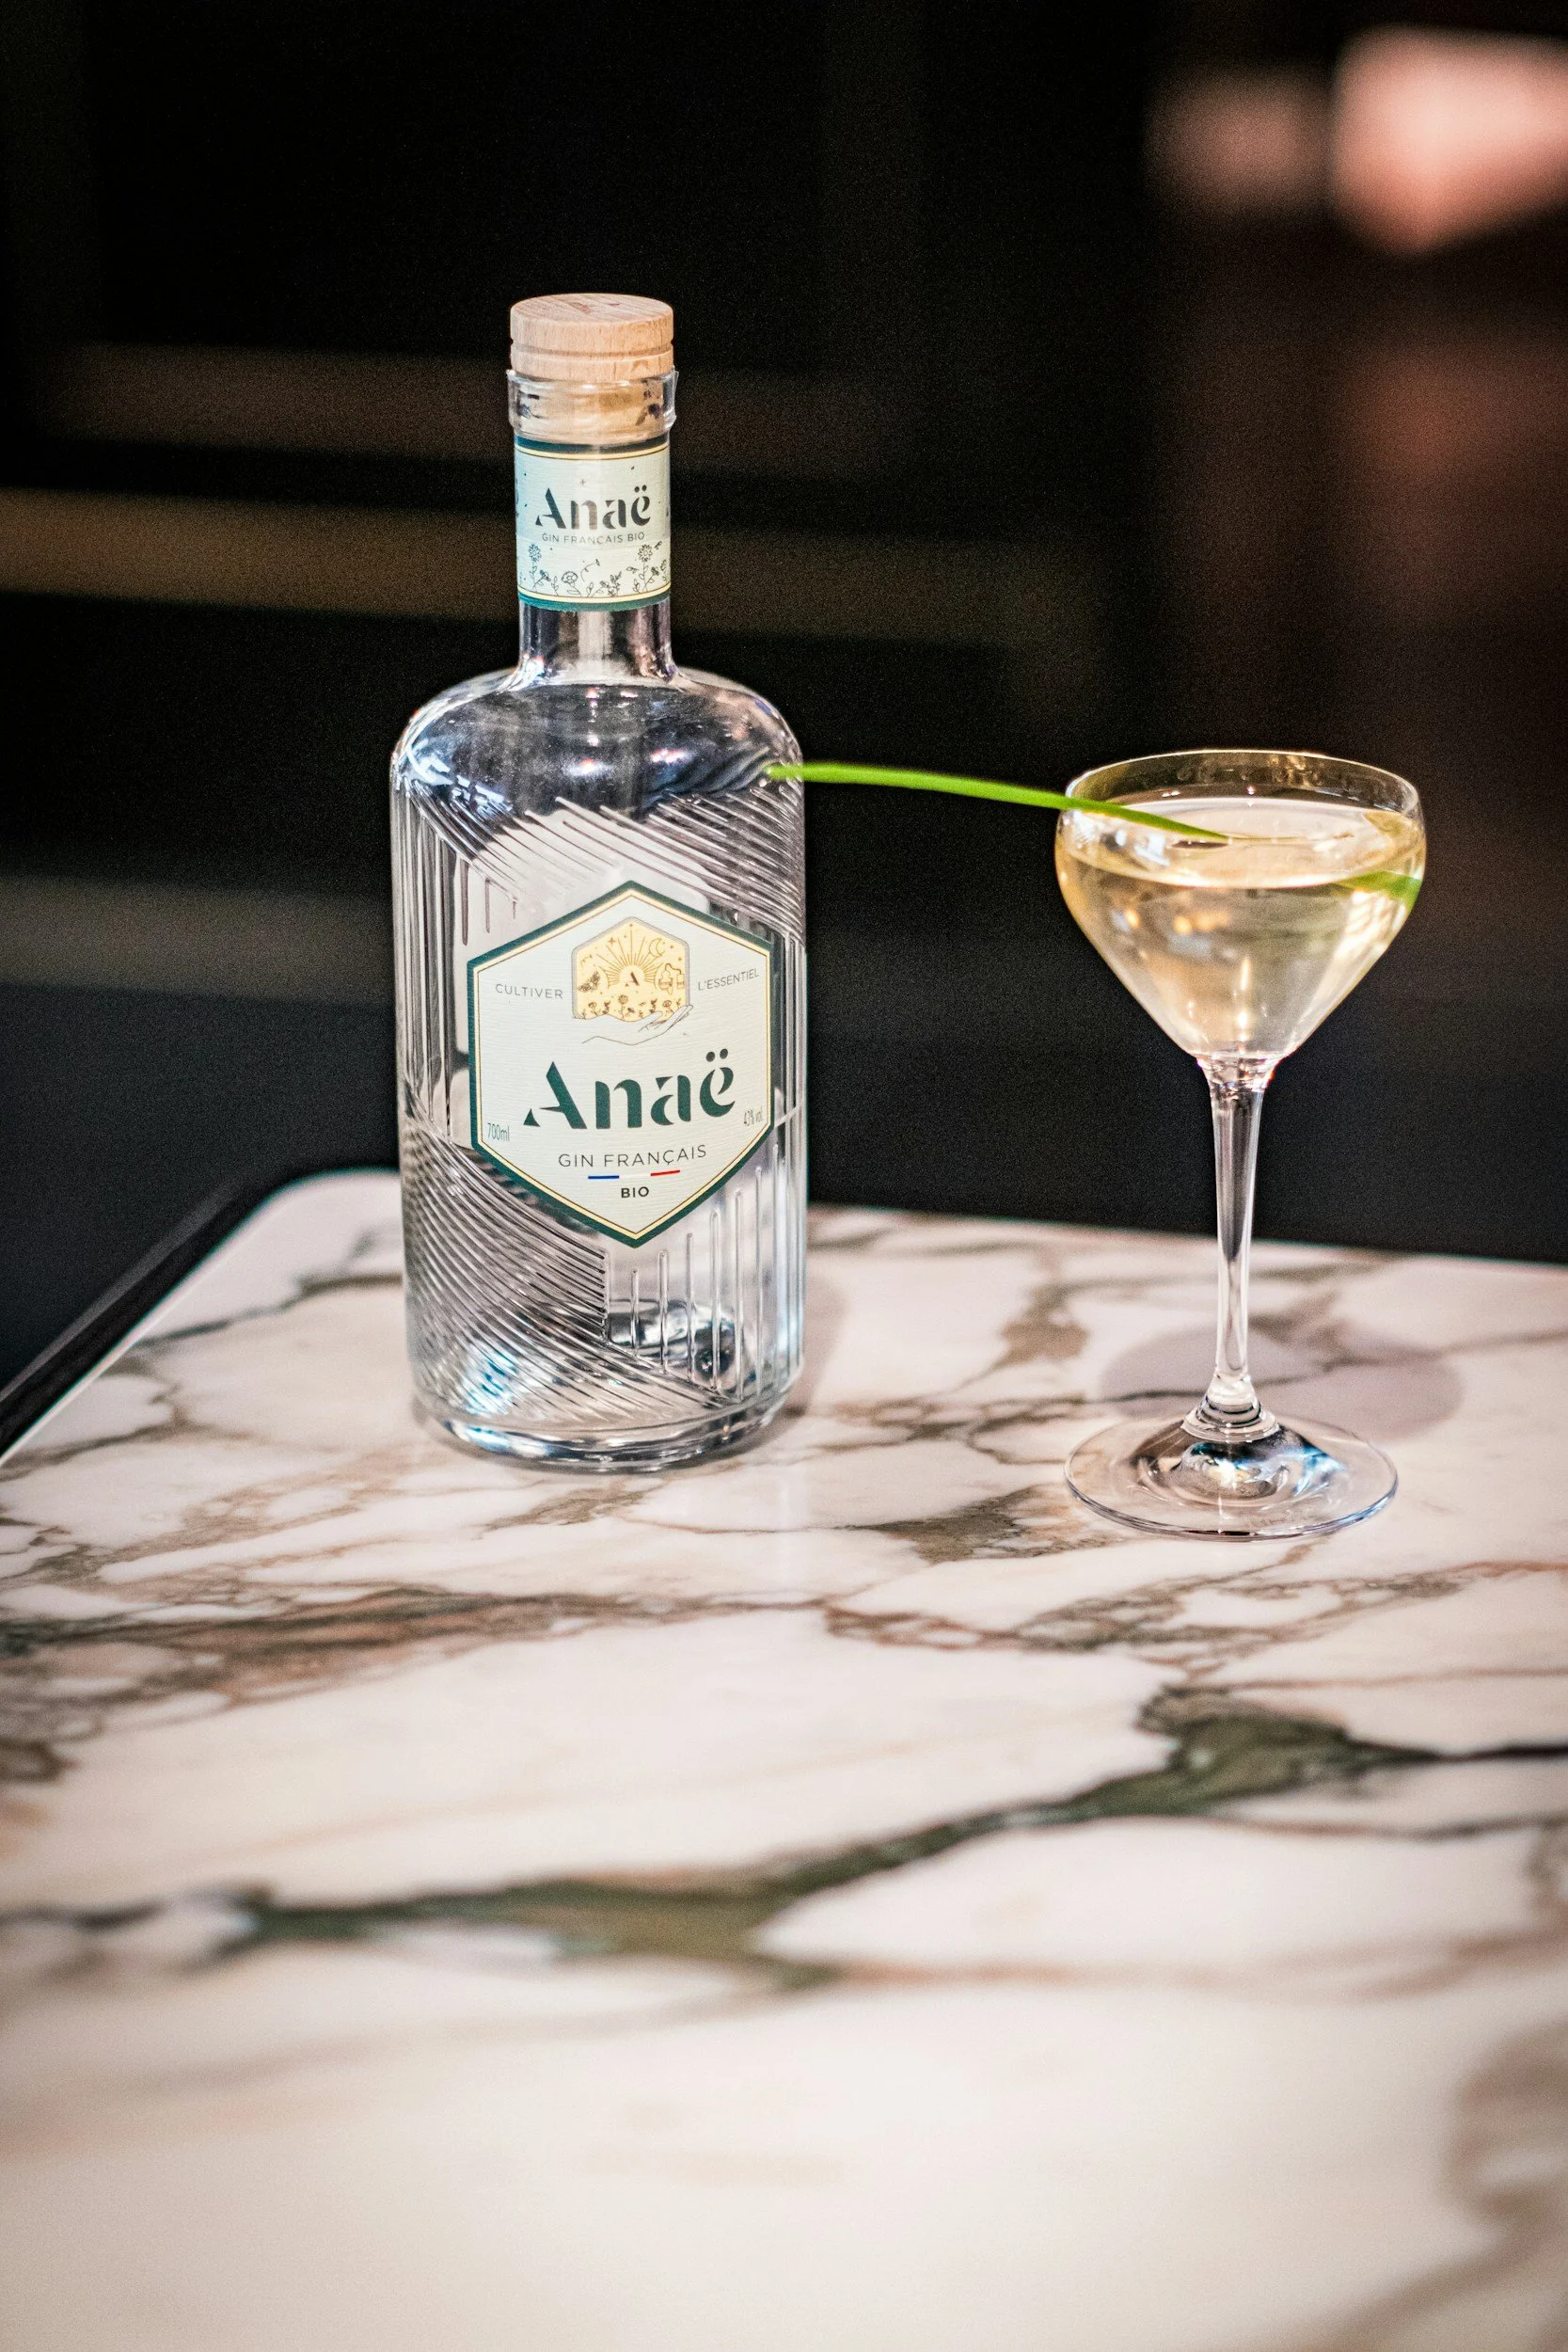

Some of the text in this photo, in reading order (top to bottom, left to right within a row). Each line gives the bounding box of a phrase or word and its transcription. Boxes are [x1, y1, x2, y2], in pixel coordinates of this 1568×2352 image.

[535, 485, 651, 530] Anaë
[542, 532, 645, 545] GIN FRANÇAIS BIO
[698, 967, 760, 991] L'ESSENTIEL
[495, 983, 563, 999] CULTIVER
[523, 1048, 736, 1130] Anaë
[487, 1122, 510, 1141] 700ml
[558, 1144, 706, 1168] GIN FRANÇAIS
[621, 1186, 649, 1199] BIO
